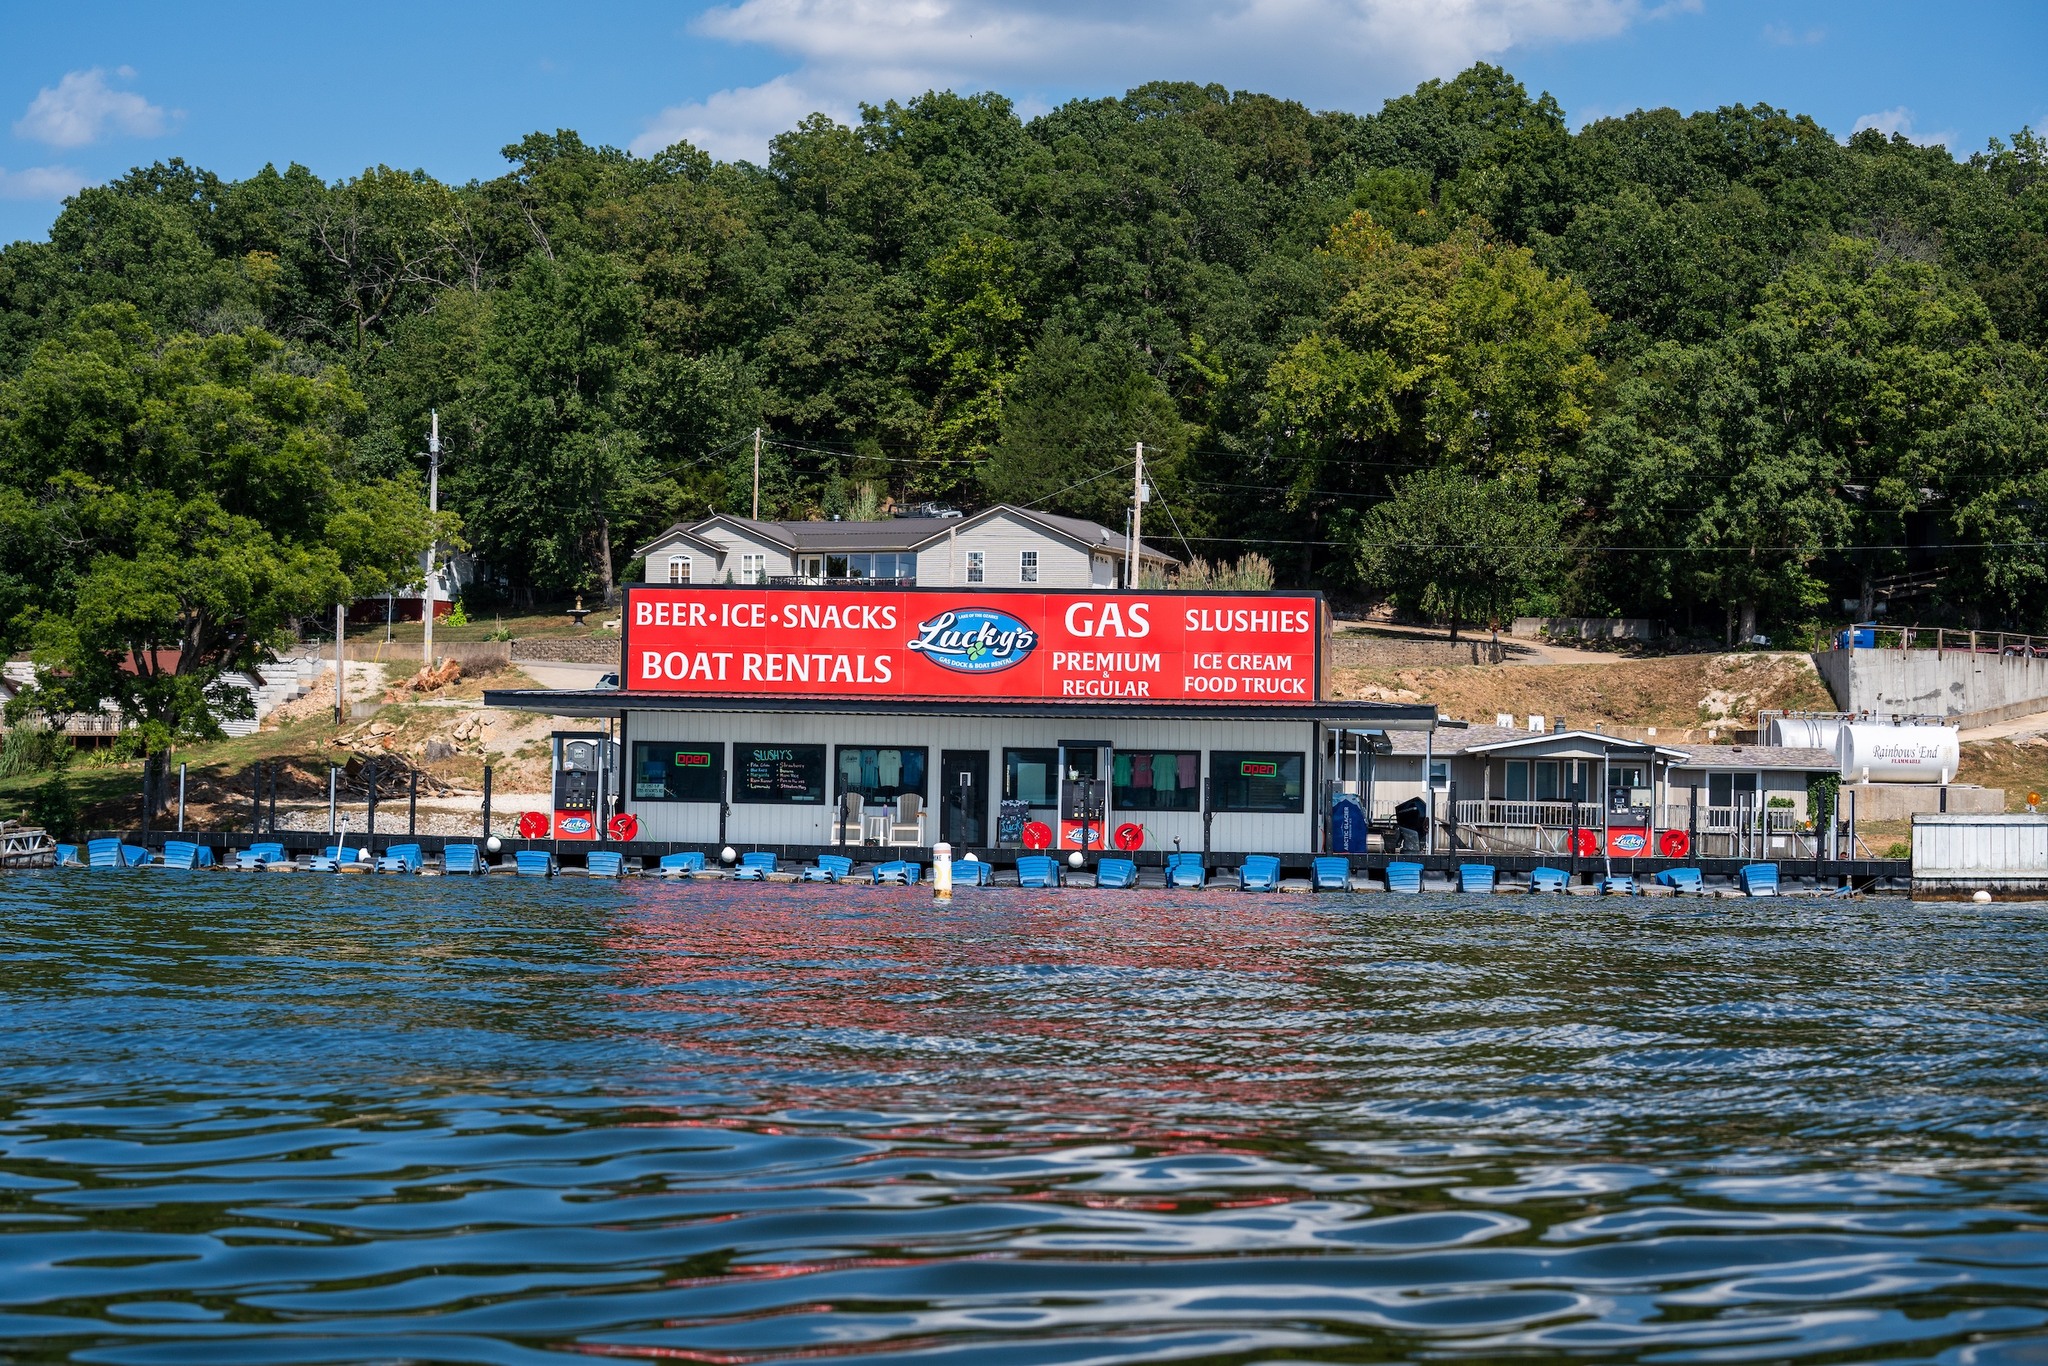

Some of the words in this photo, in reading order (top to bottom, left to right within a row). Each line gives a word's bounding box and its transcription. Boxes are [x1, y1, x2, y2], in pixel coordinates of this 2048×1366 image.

[635, 602, 708, 627] BEER
[721, 603, 766, 628] ICE
[782, 604, 898, 630] SNACKS
[1064, 601, 1151, 638] GAS
[1185, 608, 1310, 633] SLUSHIES
[907, 611, 1036, 658] Lucky's
[641, 651, 734, 681] BOAT
[741, 652, 893, 684] RENTALS
[939, 656, 951, 665] GAS
[951, 660, 969, 668] DOCK
[990, 657, 1014, 669] RENTAL
[1052, 652, 1161, 673] PREMIUM
[1193, 653, 1223, 670] ICE
[1227, 654, 1293, 671] CREAM
[1102, 671, 1110, 679] &
[1062, 679, 1150, 697] REGULAR
[1184, 676, 1238, 693] FOOD
[1241, 677, 1306, 694] TRUCK
[753, 749, 793, 761] SLUSHY'S
[1918, 744, 1940, 759] End
